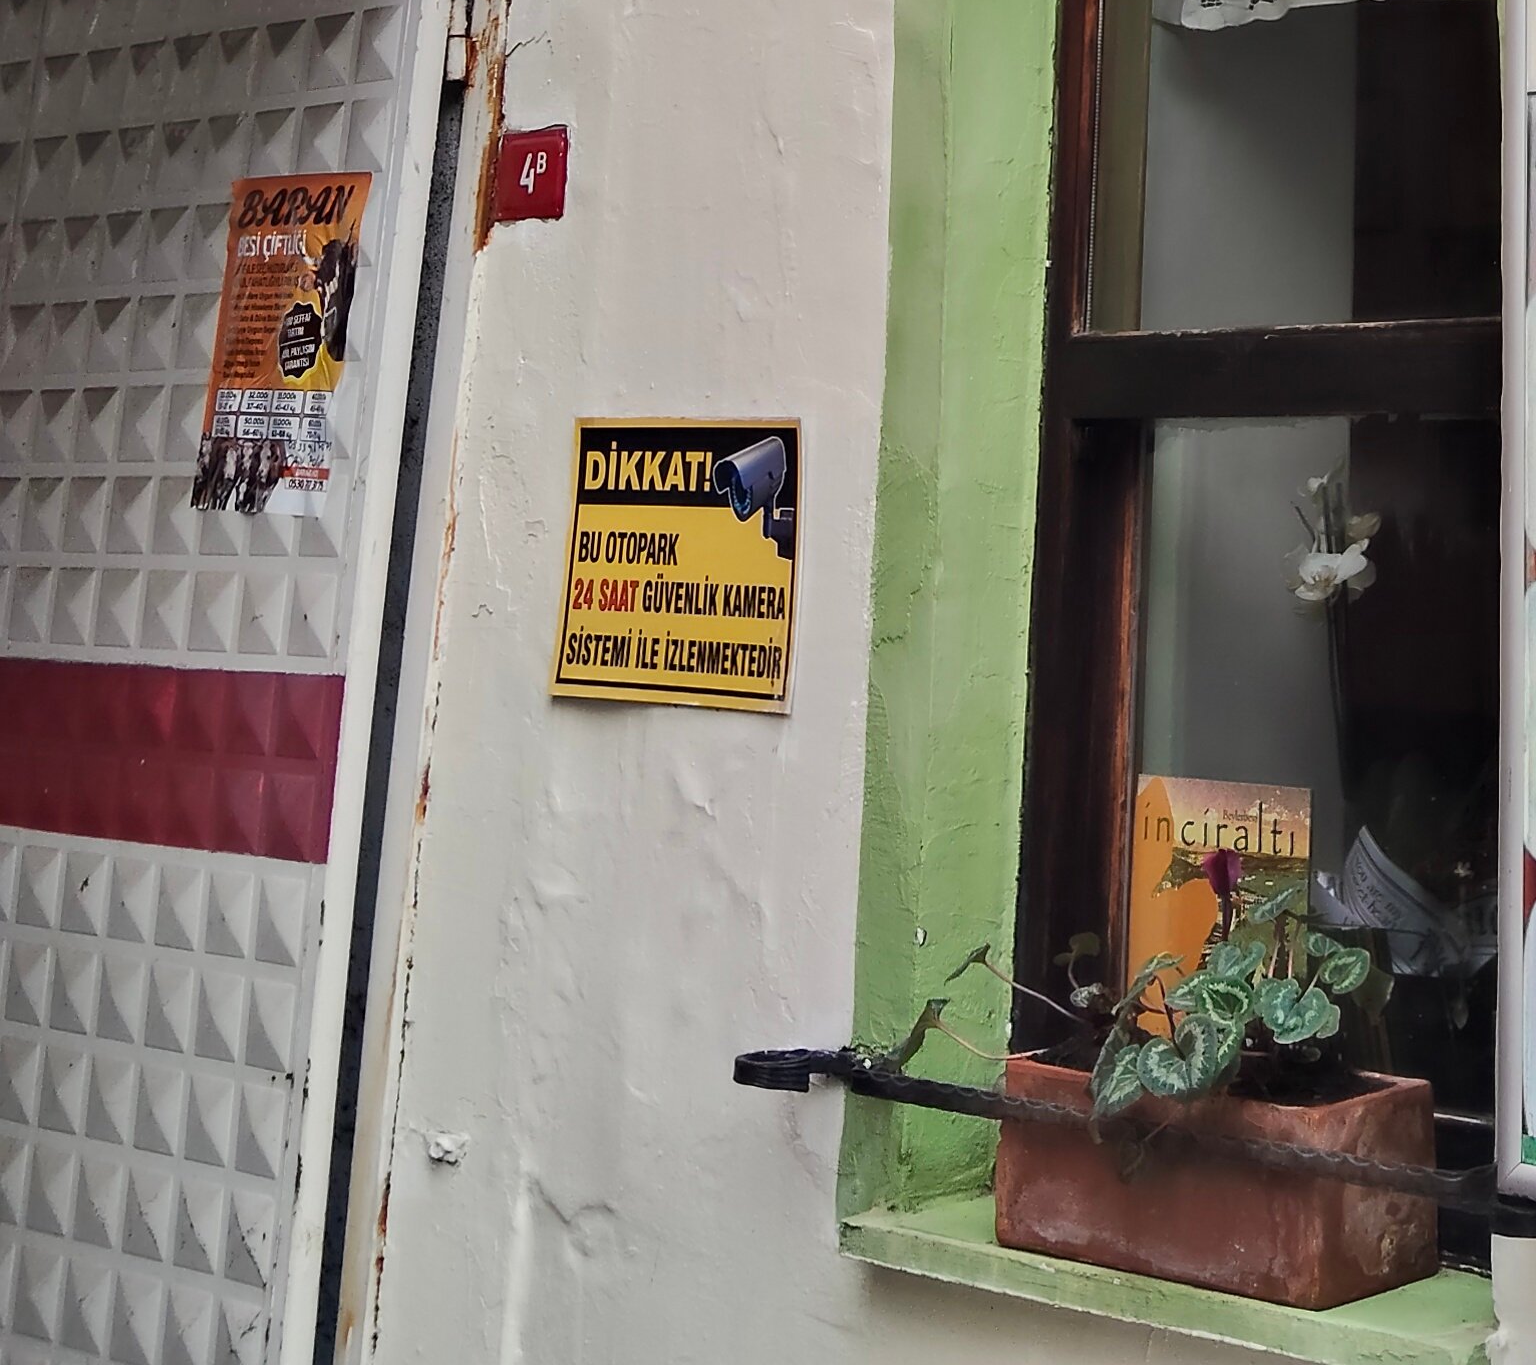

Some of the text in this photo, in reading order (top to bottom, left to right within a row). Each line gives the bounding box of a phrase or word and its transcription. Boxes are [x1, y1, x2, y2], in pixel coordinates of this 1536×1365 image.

[238, 184, 356, 229] BARAN
[584, 441, 713, 492] DİKKAT!
[578, 530, 679, 566] BU OTOPARK
[572, 573, 785, 620] 24 SAAT GÜVENLİK KAMERA
[566, 626, 782, 680] SİSTEMİ İLE İZLENMEKTEDİR
